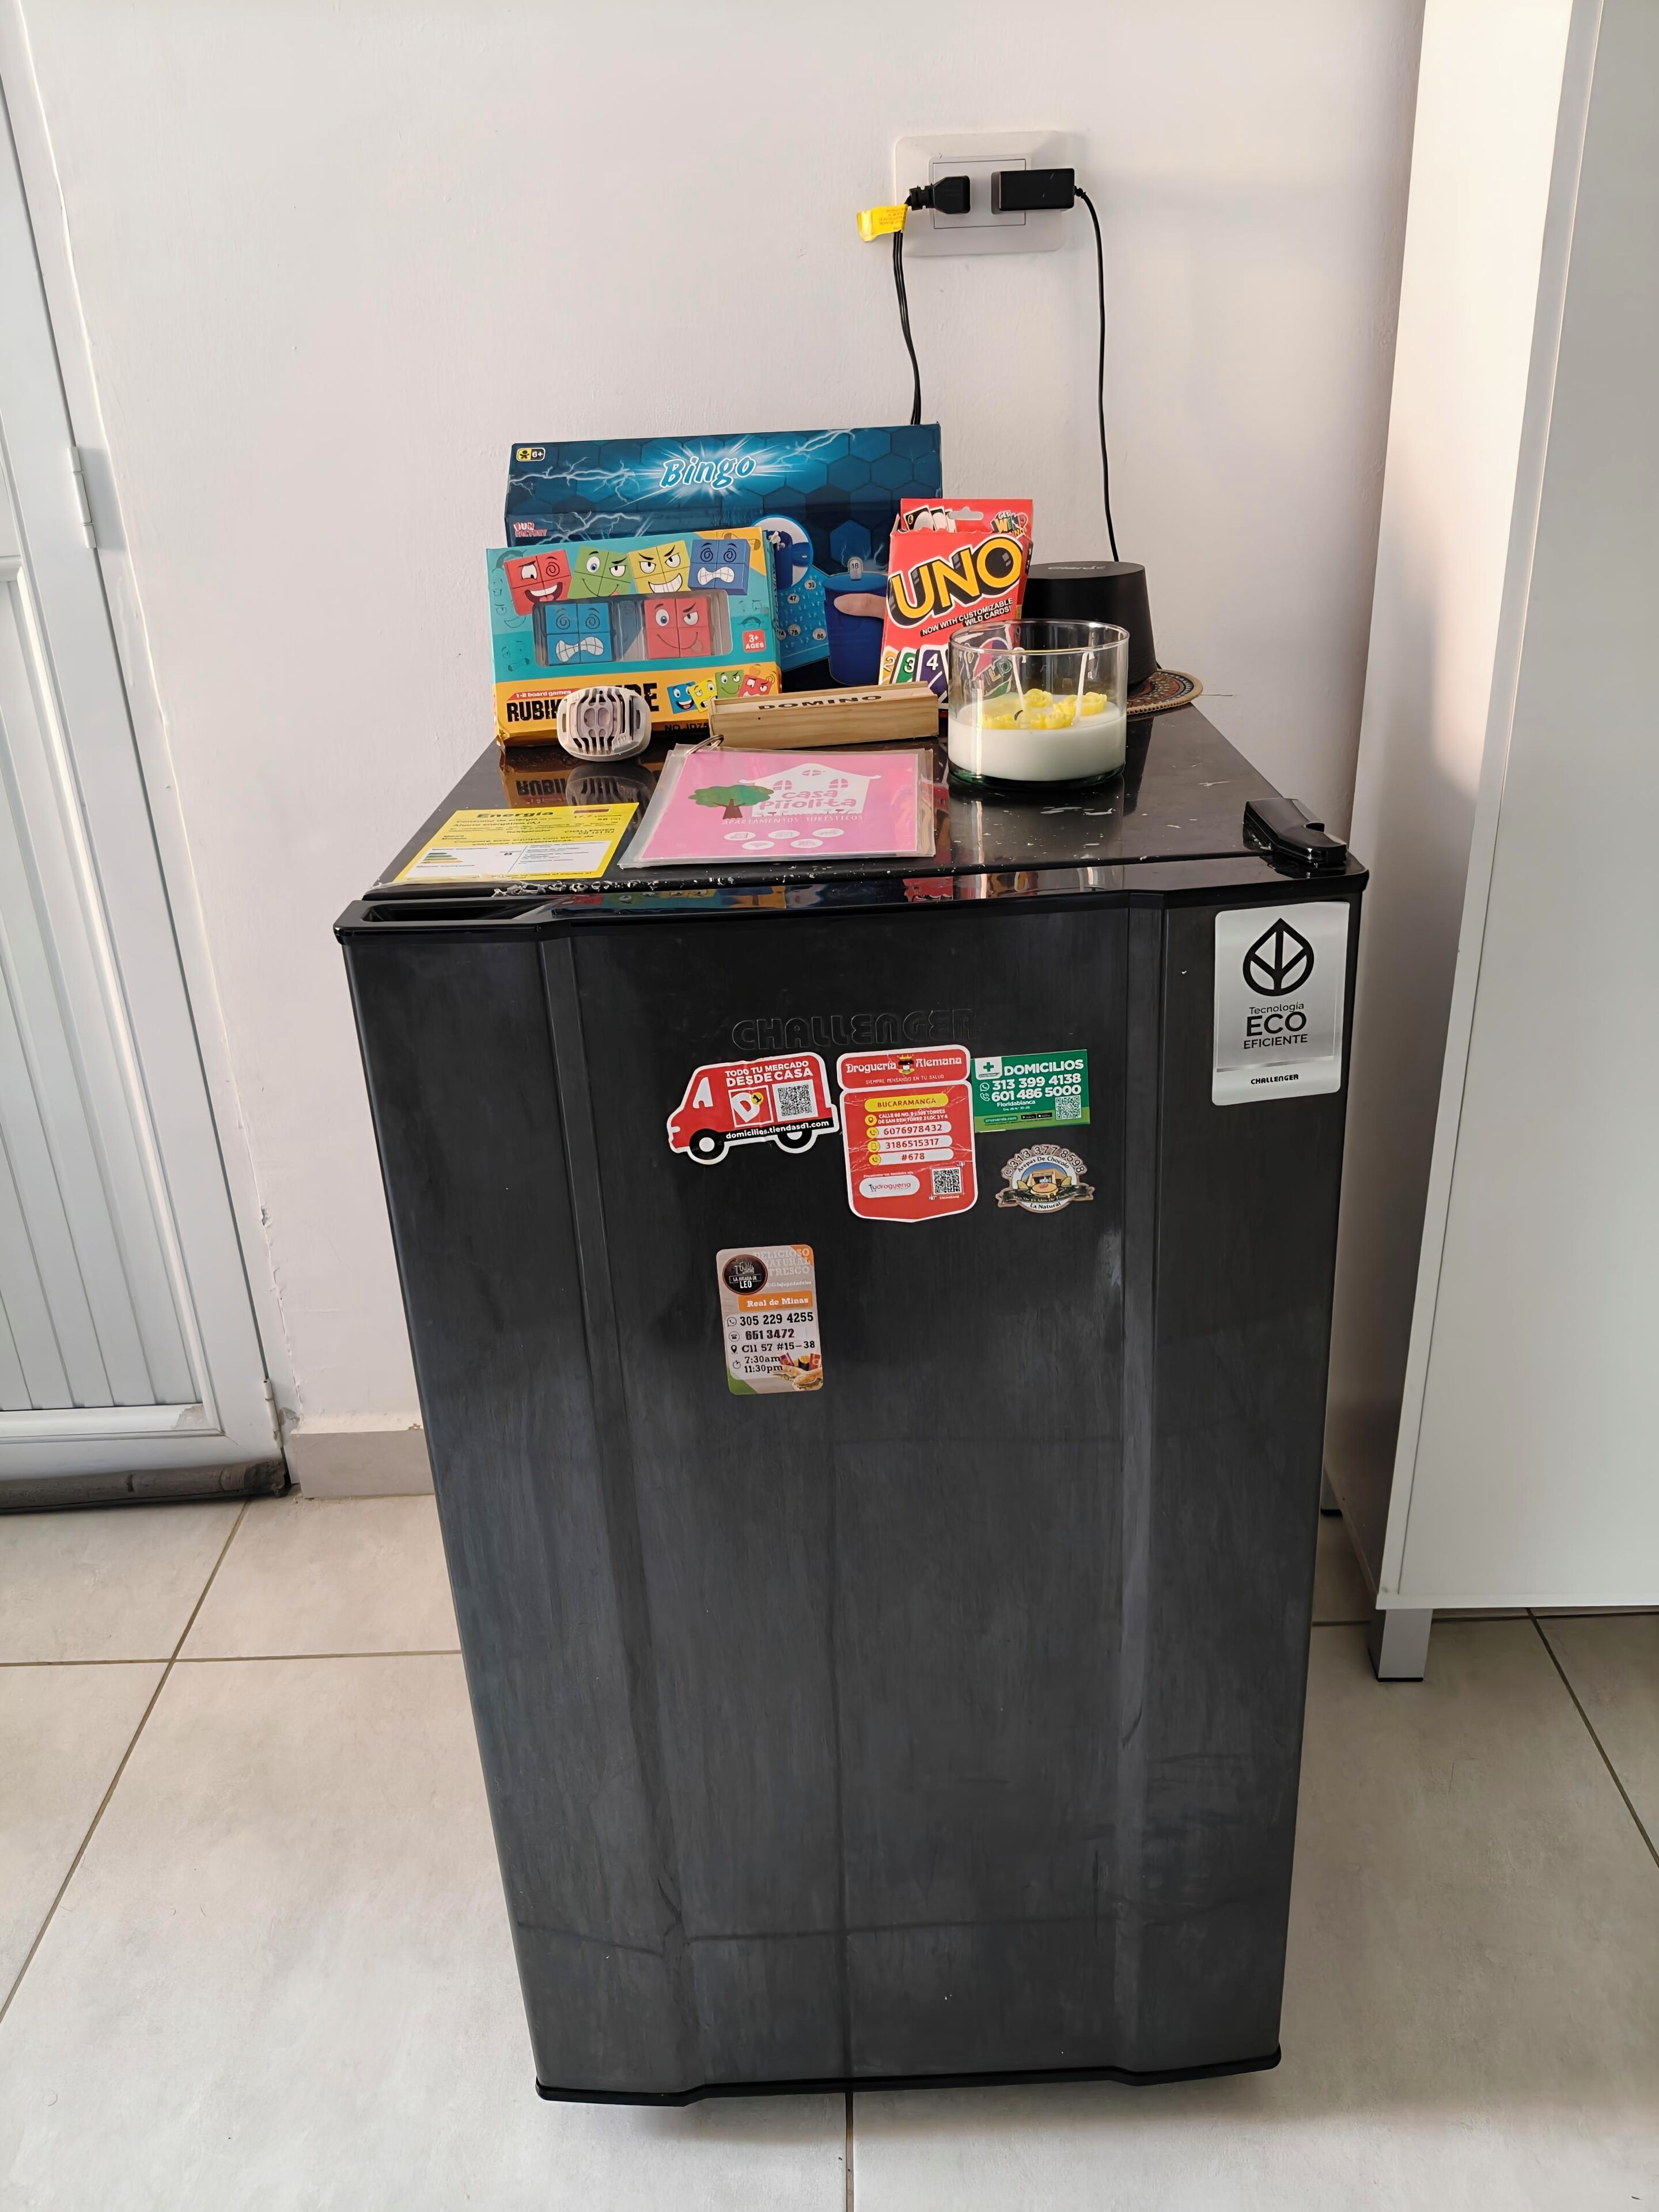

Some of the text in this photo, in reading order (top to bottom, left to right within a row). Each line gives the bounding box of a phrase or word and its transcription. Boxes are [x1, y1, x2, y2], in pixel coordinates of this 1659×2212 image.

[660, 456, 756, 490] Bingo
[888, 536, 1022, 624] UNO
[922, 598, 1013, 636] NOW WITH CUSTOMIZABLE
[964, 607, 1011, 627] WILD CARDS!
[745, 642, 764, 650] AGES
[749, 634, 759, 643] 3+
[883, 656, 894, 672] 2
[903, 657, 915, 673] 3
[926, 653, 939, 671] 4
[549, 690, 572, 698] games
[759, 695, 882, 710] DOMINO
[782, 790, 838, 799] casa
[732, 1009, 978, 1051] CHALLENGER
[1247, 1011, 1306, 1037] ECO
[1243, 1033, 1308, 1050] EFICIENTE
[725, 1069, 748, 1077] TODO
[765, 1060, 809, 1072] MERCADO
[846, 1056, 962, 1074] Droguería Alemana
[1004, 1059, 1084, 1076] DOMICILIOS
[726, 1067, 813, 1088] DESDE CASA
[992, 1073, 1082, 1090] 313 399 4138
[1251, 1074, 1299, 1085] CHALLENGER
[991, 1085, 1082, 1102] 601 486 5000
[877, 1098, 936, 1108] BUCARAMANGA
[726, 1120, 830, 1139] domicilios.tiendasd1.com
[884, 1124, 942, 1135] 6076978432
[885, 1138, 939, 1149] 3186515317
[901, 1153, 925, 1161] #678
[1010, 1146, 1086, 1174] 313 377 8598
[1017, 1159, 1036, 1173] Arepas
[1047, 1156, 1070, 1169] Chocolo
[1038, 1202, 1061, 1210] Natural
[755, 1248, 810, 1260] DELICIOSO
[768, 1266, 810, 1277] FRESCO
[740, 1280, 752, 1289] LEO
[747, 1300, 767, 1308] Real
[782, 1297, 809, 1305] Minas
[740, 1312, 814, 1326] 305 229 4255
[767, 1328, 795, 1340] 3472
[761, 1343, 772, 1352] 57
[744, 1355, 781, 1363] 7:30am
[744, 1365, 783, 1374] 11:30pm
